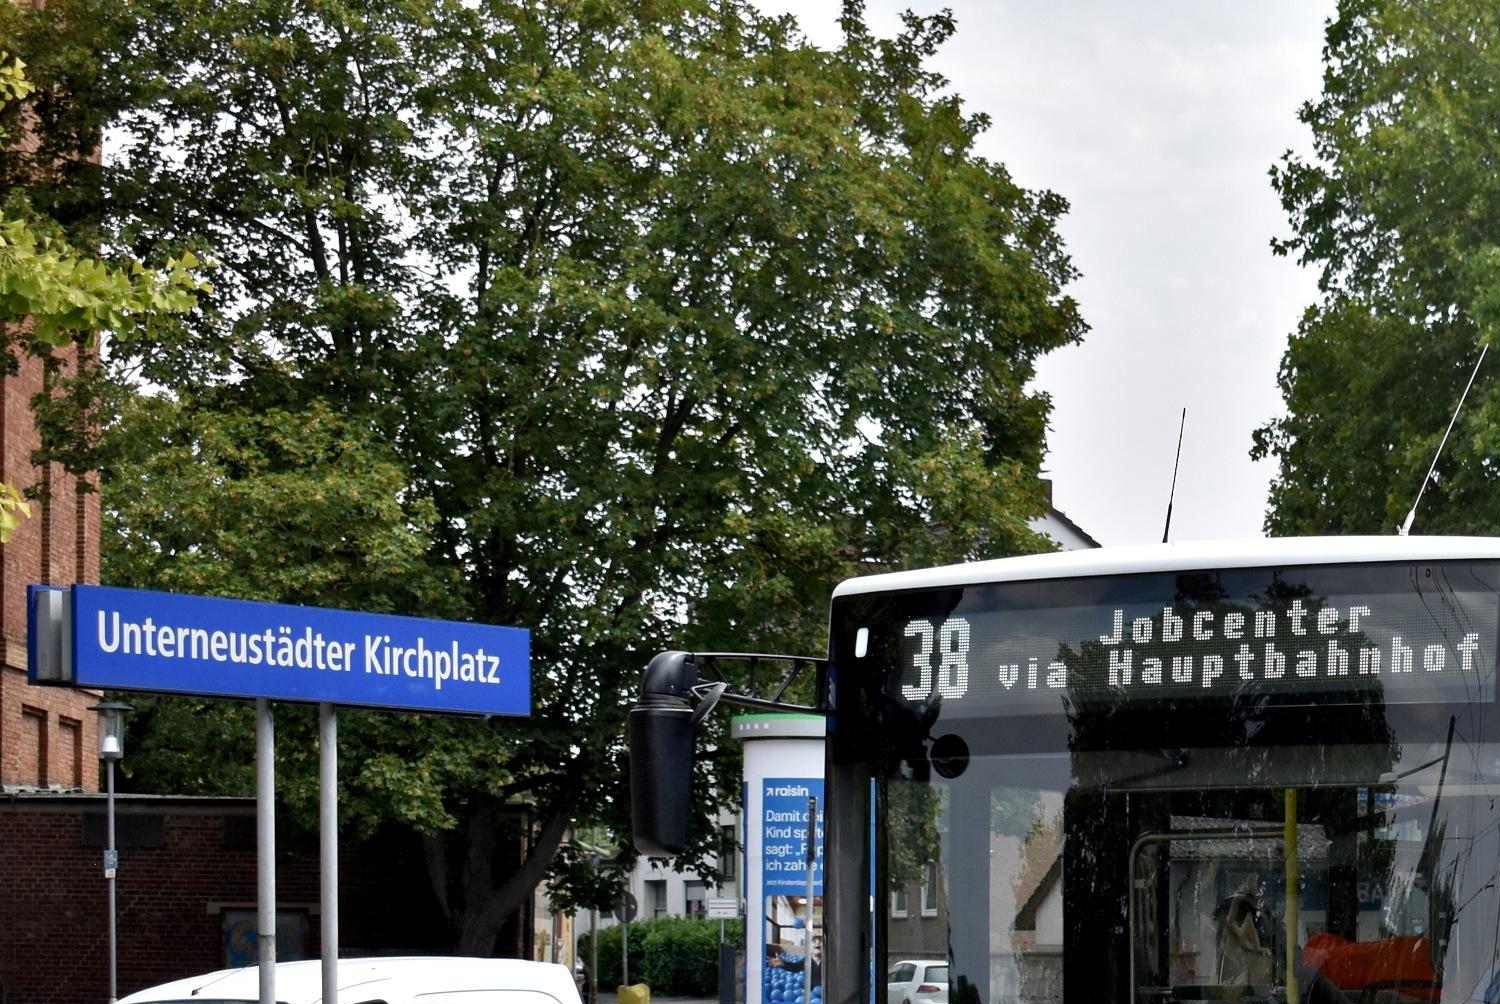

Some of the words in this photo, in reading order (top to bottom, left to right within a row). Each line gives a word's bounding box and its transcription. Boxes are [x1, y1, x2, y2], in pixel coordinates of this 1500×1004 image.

[1100, 600, 1371, 645] Jobcenter
[98, 610, 355, 672] Unterneustädter
[364, 635, 501, 690] Kirchplatz
[901, 617, 971, 701] 38
[999, 657, 1067, 690] via
[1108, 632, 1479, 688] Hauptbahnhof
[774, 785, 809, 797] raisin
[766, 810, 801, 822] Damit
[766, 826, 792, 839] Kind
[765, 844, 793, 858] sagt:
[766, 859, 782, 871] ich
[784, 859, 818, 871] zahe
